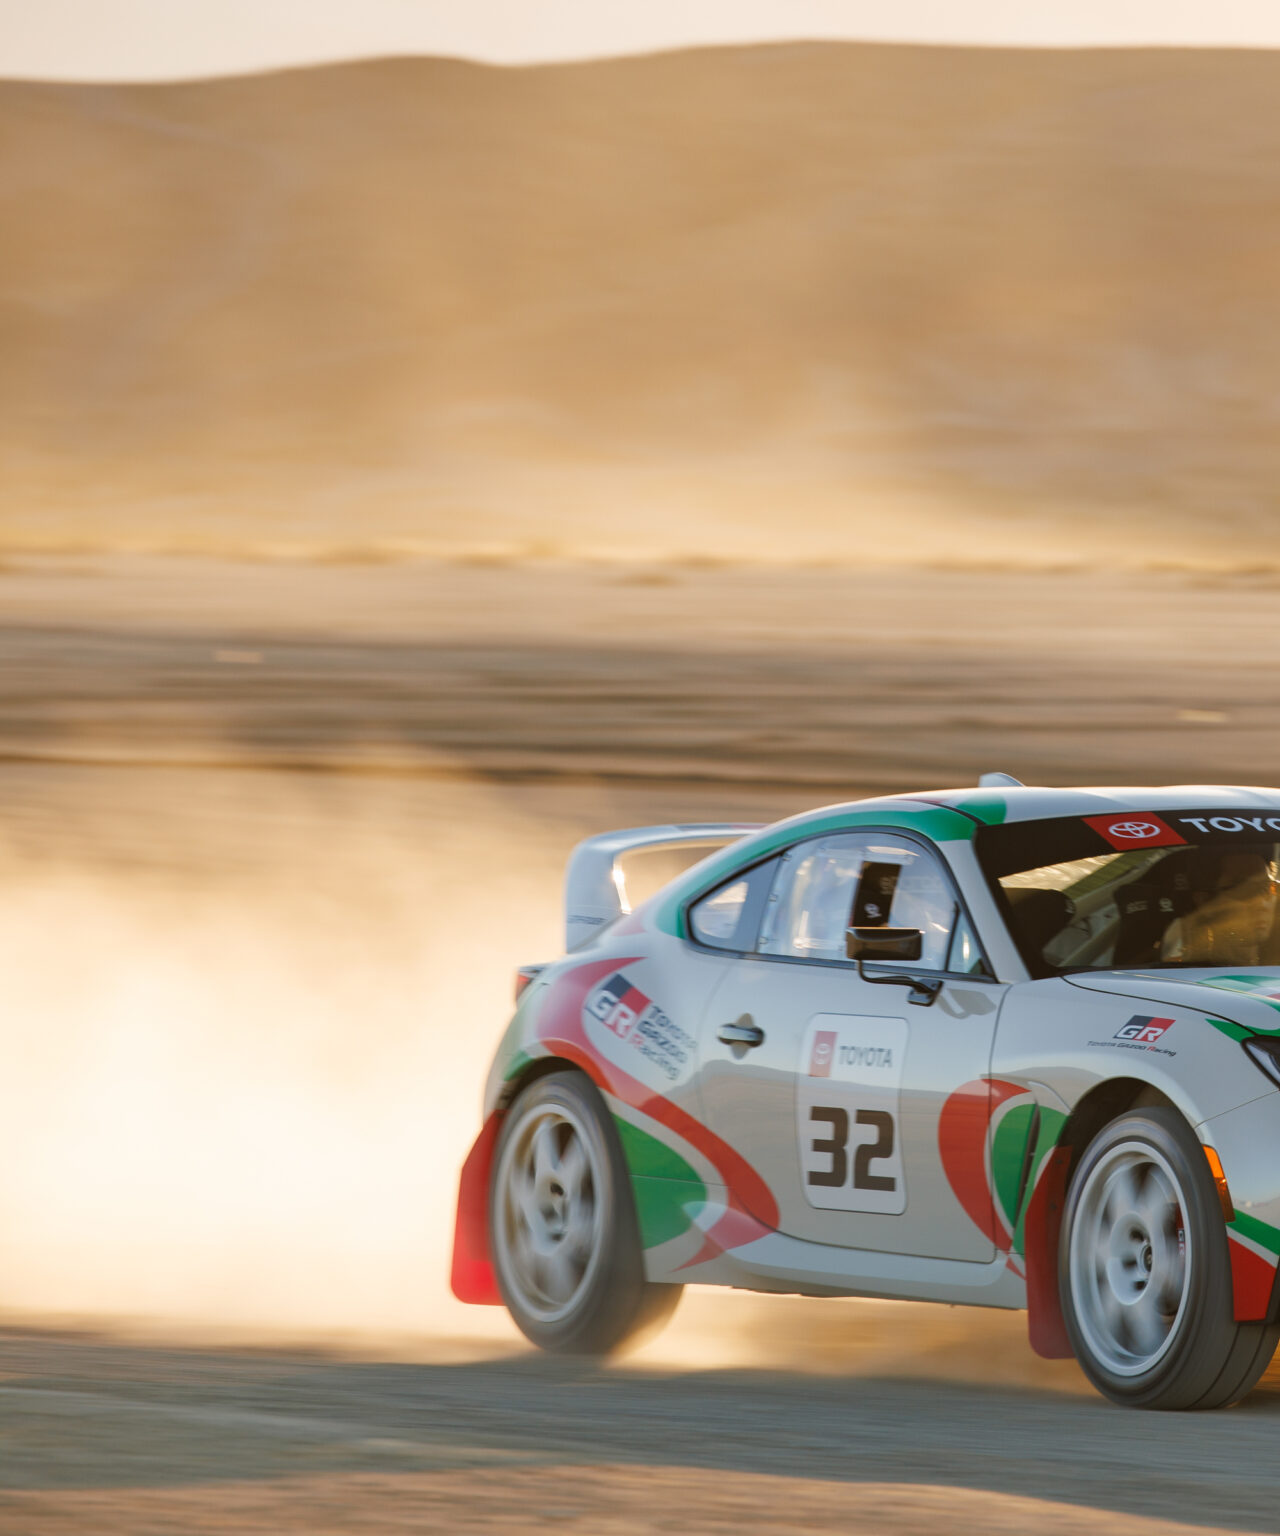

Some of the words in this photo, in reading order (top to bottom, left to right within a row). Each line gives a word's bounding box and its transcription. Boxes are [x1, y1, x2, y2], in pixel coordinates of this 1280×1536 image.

[586, 989, 636, 1038] GR
[648, 1004, 698, 1050] TOYOTA
[1116, 1024, 1164, 1042] GR
[628, 1033, 681, 1081] Racing
[838, 1045, 893, 1069] TOYOTA
[1147, 1046, 1177, 1057] Racing
[807, 1105, 897, 1192] 32
